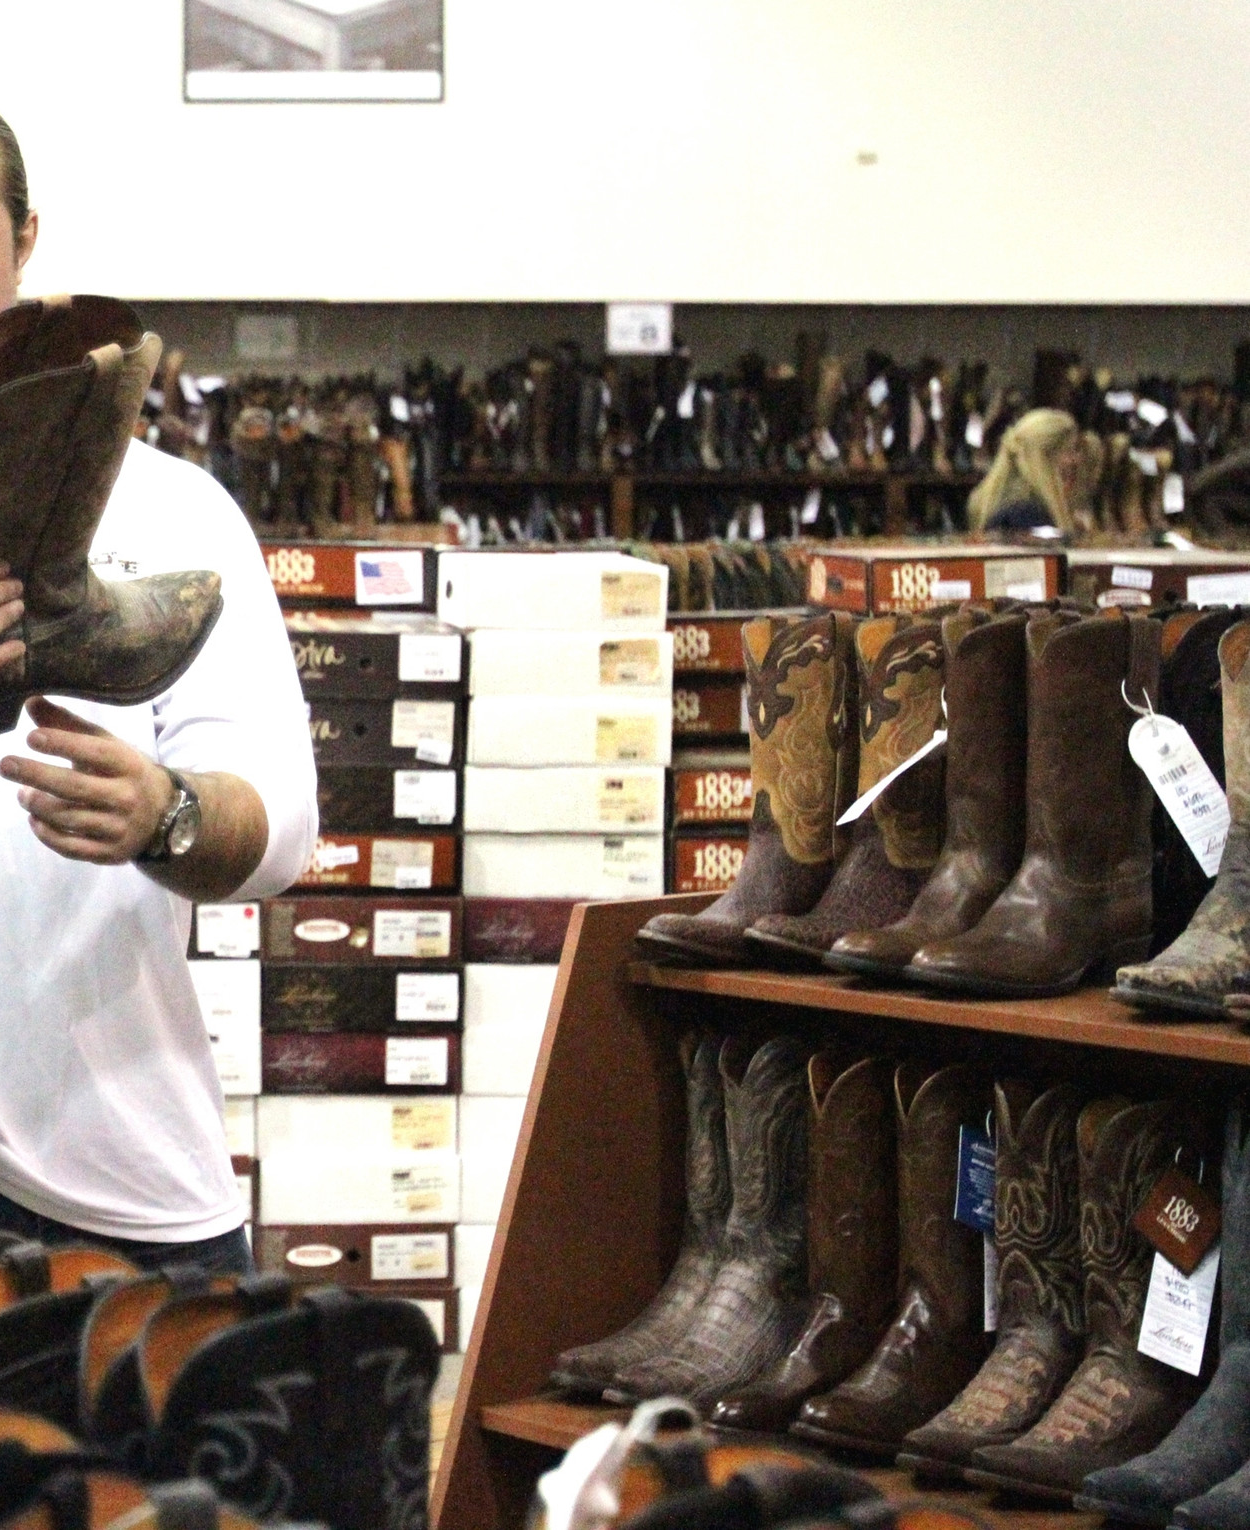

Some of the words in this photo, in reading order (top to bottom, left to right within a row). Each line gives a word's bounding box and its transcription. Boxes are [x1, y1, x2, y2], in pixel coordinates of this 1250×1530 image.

[267, 548, 315, 584] 1883
[673, 624, 710, 661] 883
[694, 772, 744, 810] 1883
[1164, 1195, 1200, 1233] 1883
